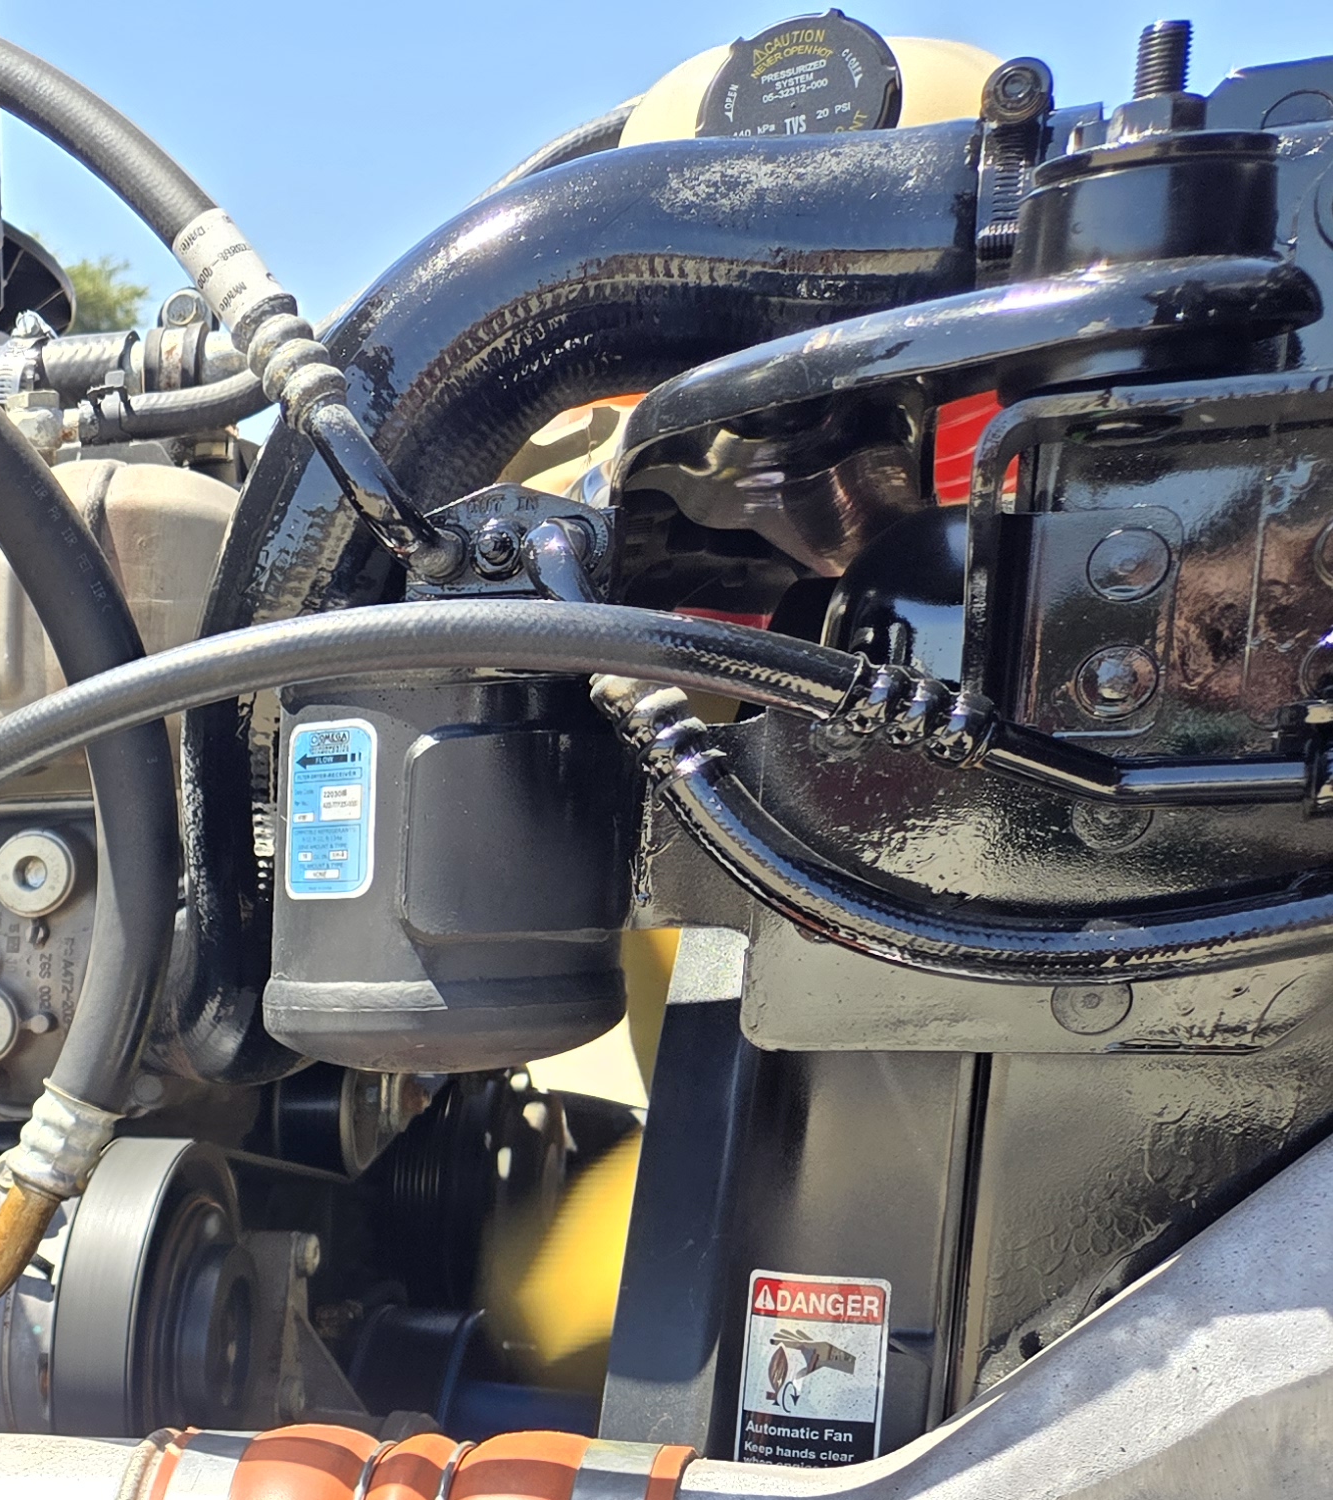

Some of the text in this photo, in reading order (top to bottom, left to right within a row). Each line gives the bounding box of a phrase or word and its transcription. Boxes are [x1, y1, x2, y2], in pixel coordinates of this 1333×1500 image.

[764, 29, 825, 55] CAUTION
[750, 45, 833, 79] NEVER OPEN HOT
[761, 59, 827, 84] PRESSURIZED
[762, 78, 829, 104] 05-32312-000
[775, 73, 814, 91] SYSTEM
[724, 84, 739, 110] OPEN
[816, 101, 851, 120] 20 PSI
[784, 114, 807, 135] TVS
[315, 756, 334, 765] FLOW
[776, 1289, 879, 1318] DANGER
[745, 1420, 853, 1442] Automatic Fan
[744, 1441, 855, 1462] Keep hands clear
